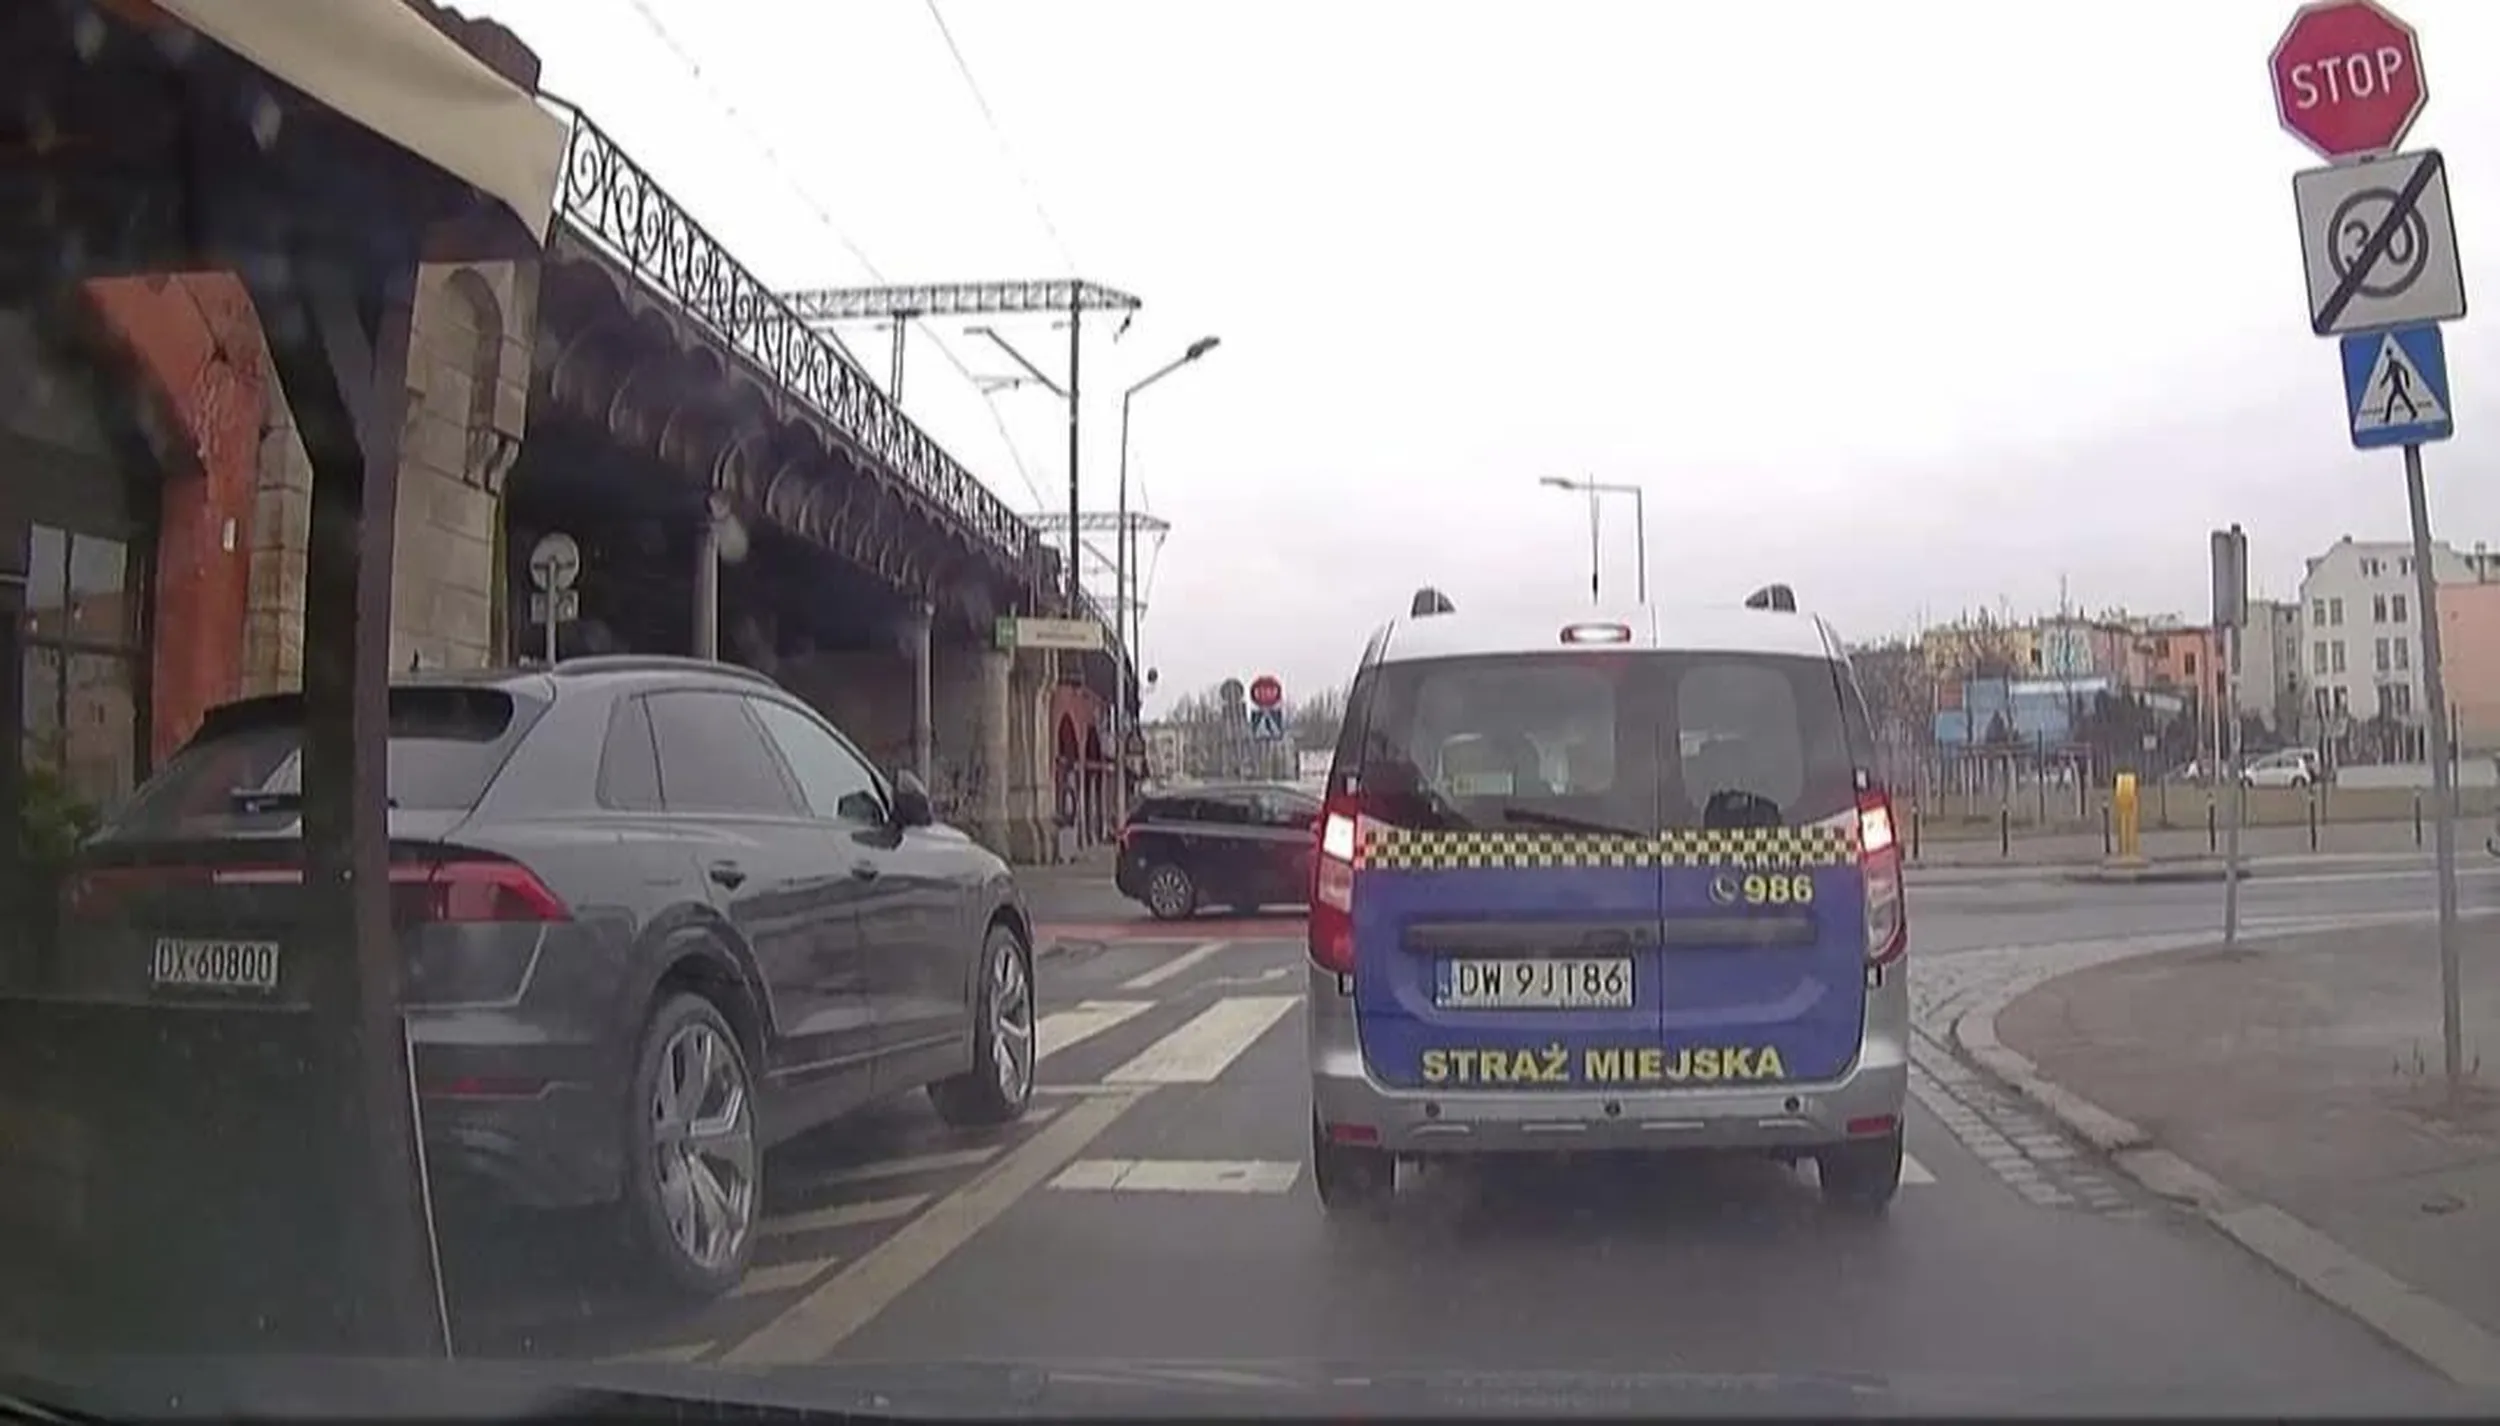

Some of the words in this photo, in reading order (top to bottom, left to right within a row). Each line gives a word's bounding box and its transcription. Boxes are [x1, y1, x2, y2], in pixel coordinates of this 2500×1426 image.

[2291, 46, 2404, 109] STOP
[1743, 872, 1814, 905] 986
[158, 943, 186, 979] DX
[196, 944, 273, 982] 60800
[1460, 963, 1501, 996] DW
[1516, 962, 1623, 997] 9JT86
[1421, 1043, 1570, 1082] STRAŻ
[1585, 1045, 1785, 1081] MIEJSKA
